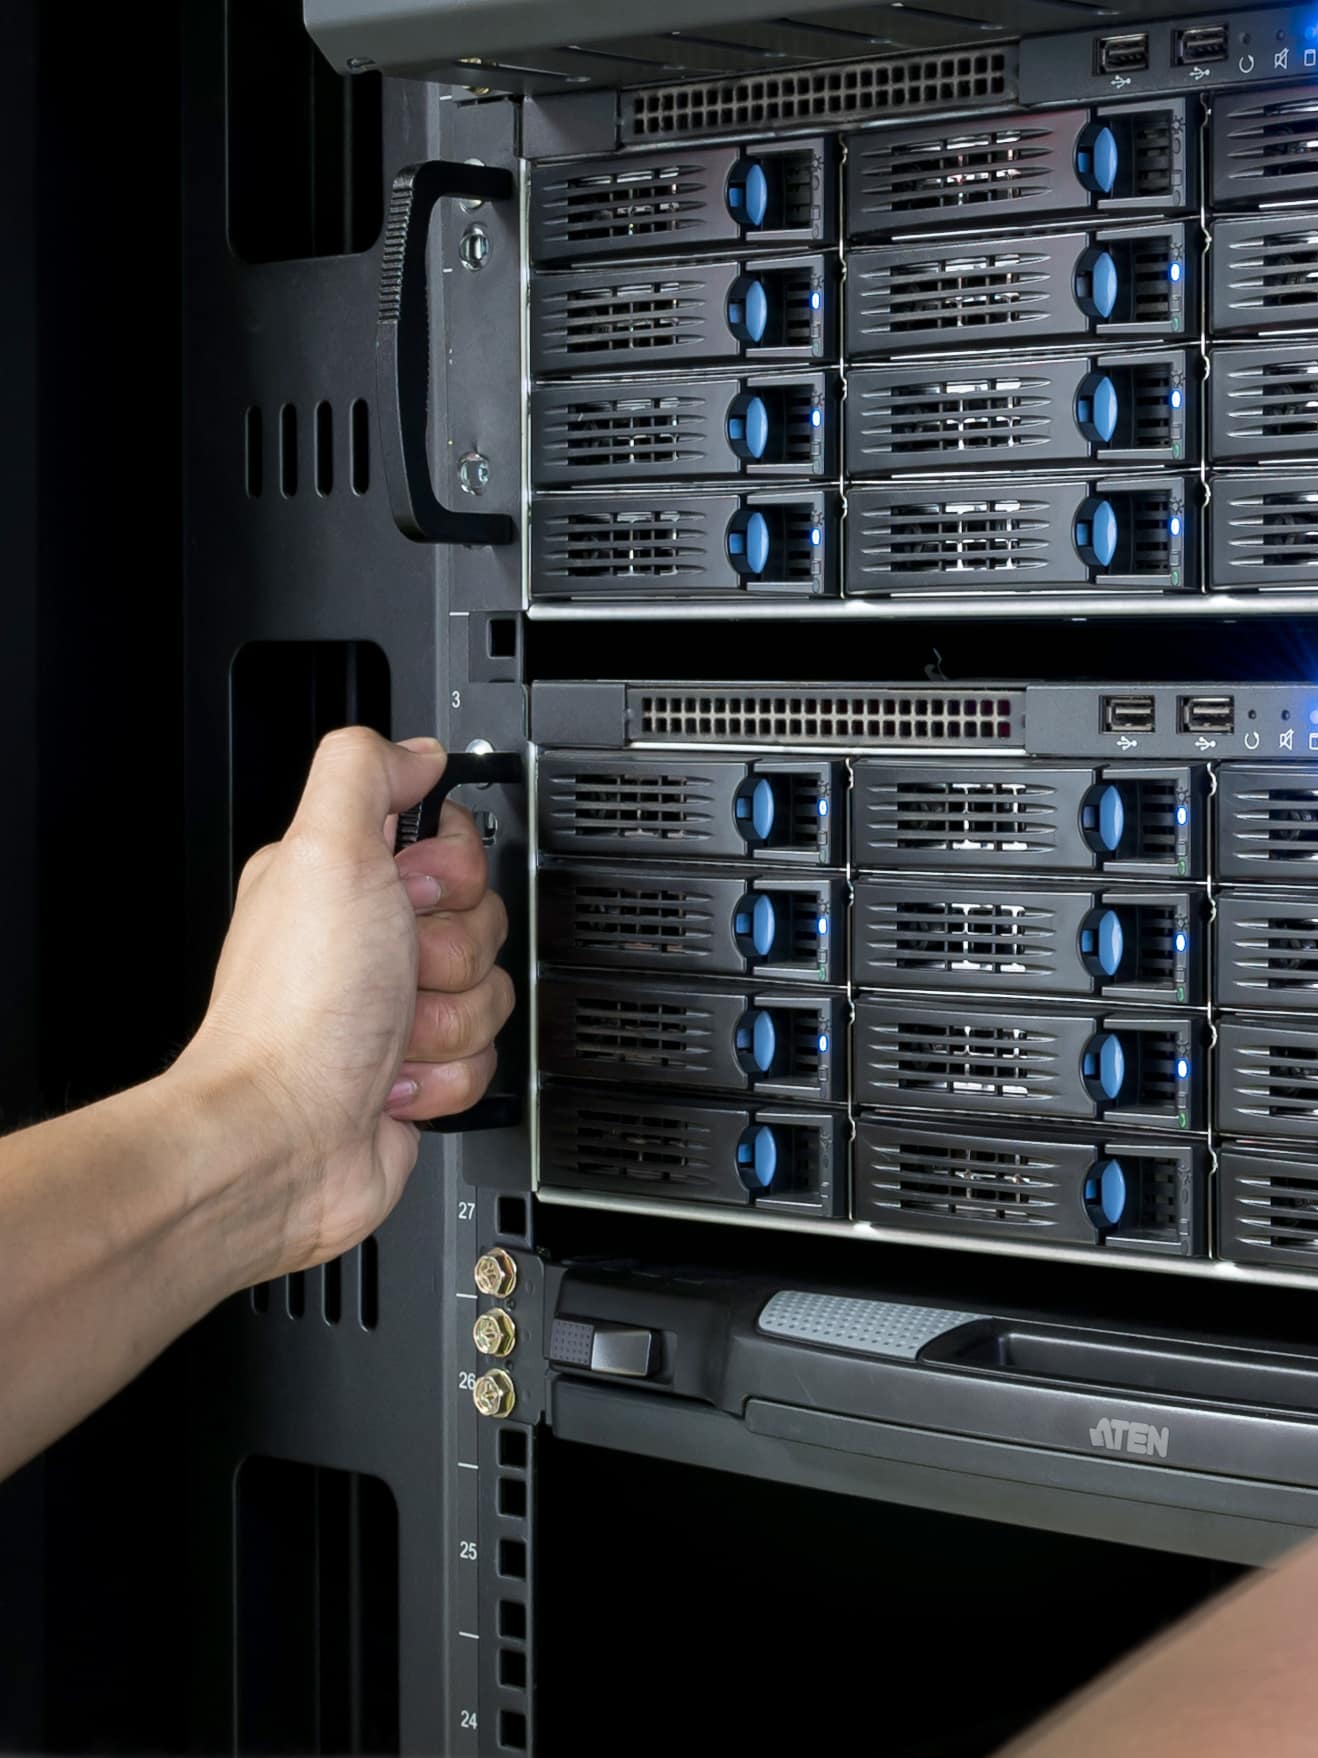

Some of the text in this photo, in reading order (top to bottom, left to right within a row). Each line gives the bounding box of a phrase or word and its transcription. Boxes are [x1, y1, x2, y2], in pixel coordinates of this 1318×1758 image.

[451, 690, 461, 708] 3
[458, 1201, 475, 1220] 27
[458, 1371, 476, 1390] 26
[1089, 1417, 1169, 1458] ATEN
[460, 1541, 477, 1560] 25
[460, 1709, 478, 1730] 24
